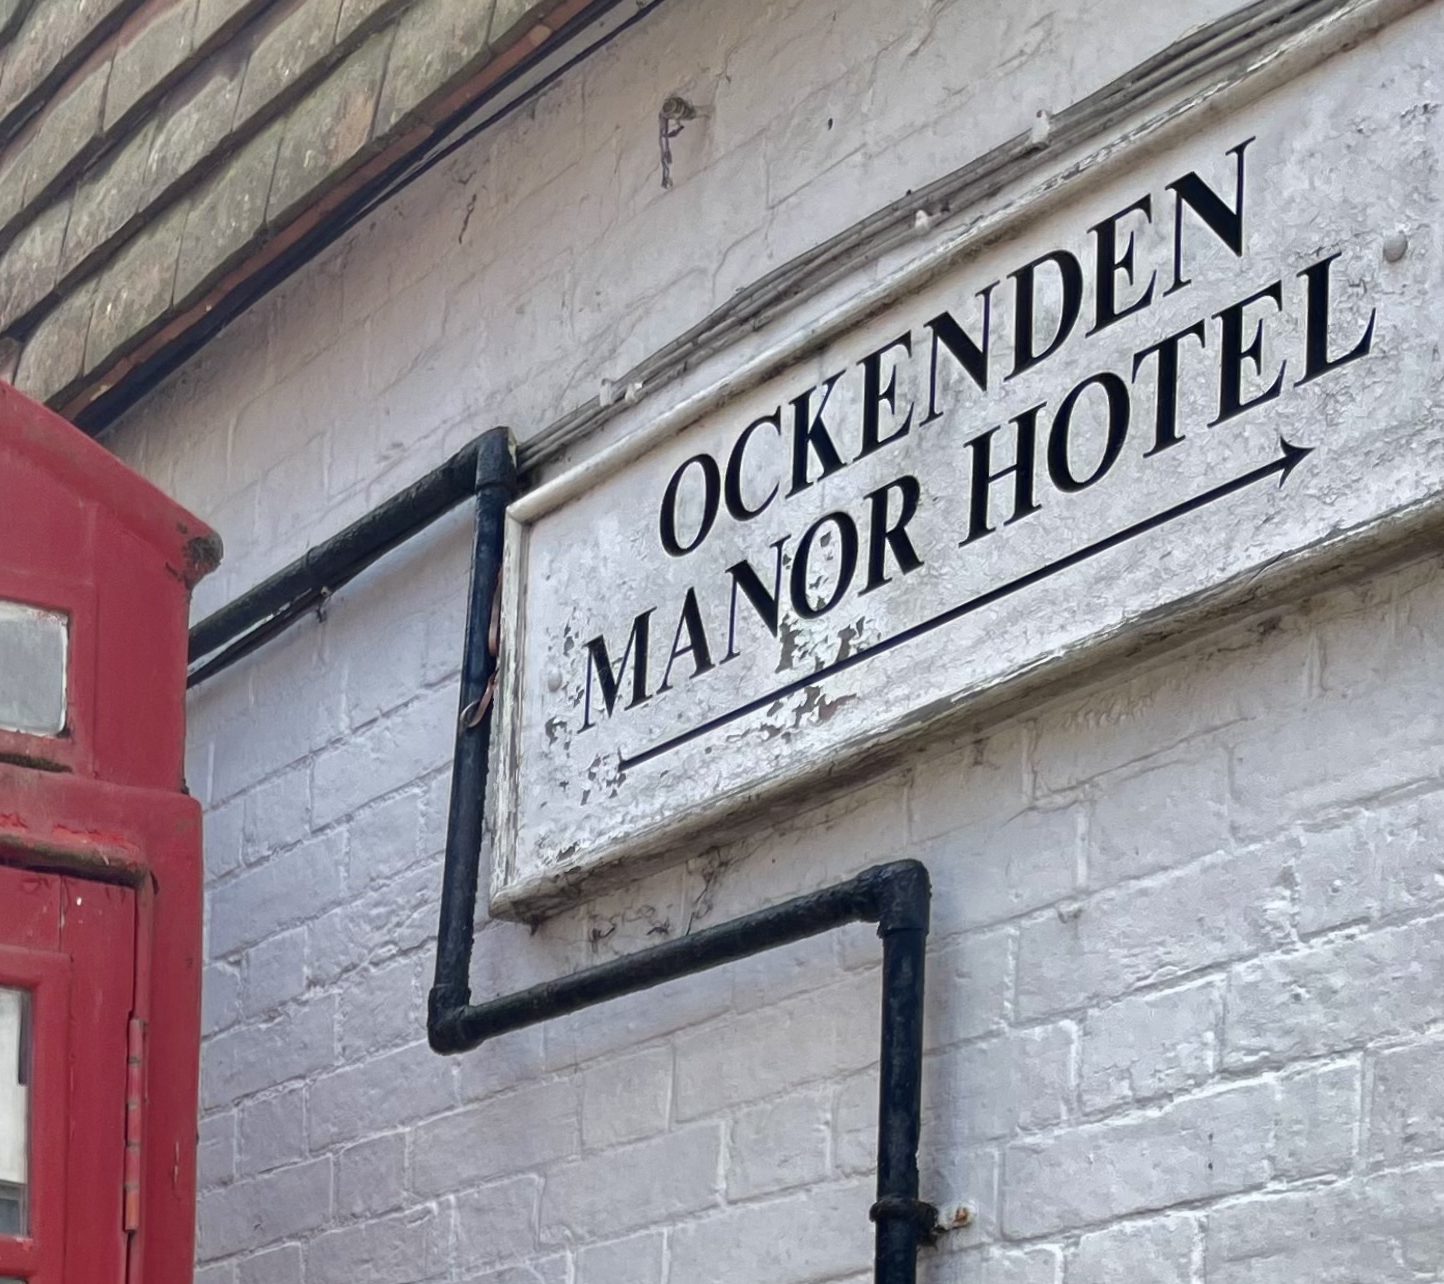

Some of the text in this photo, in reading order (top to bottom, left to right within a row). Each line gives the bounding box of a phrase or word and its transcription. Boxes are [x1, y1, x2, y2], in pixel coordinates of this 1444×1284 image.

[576, 252, 1377, 732] MANOR HOTEL
[658, 136, 1256, 558] OCKENDEN
